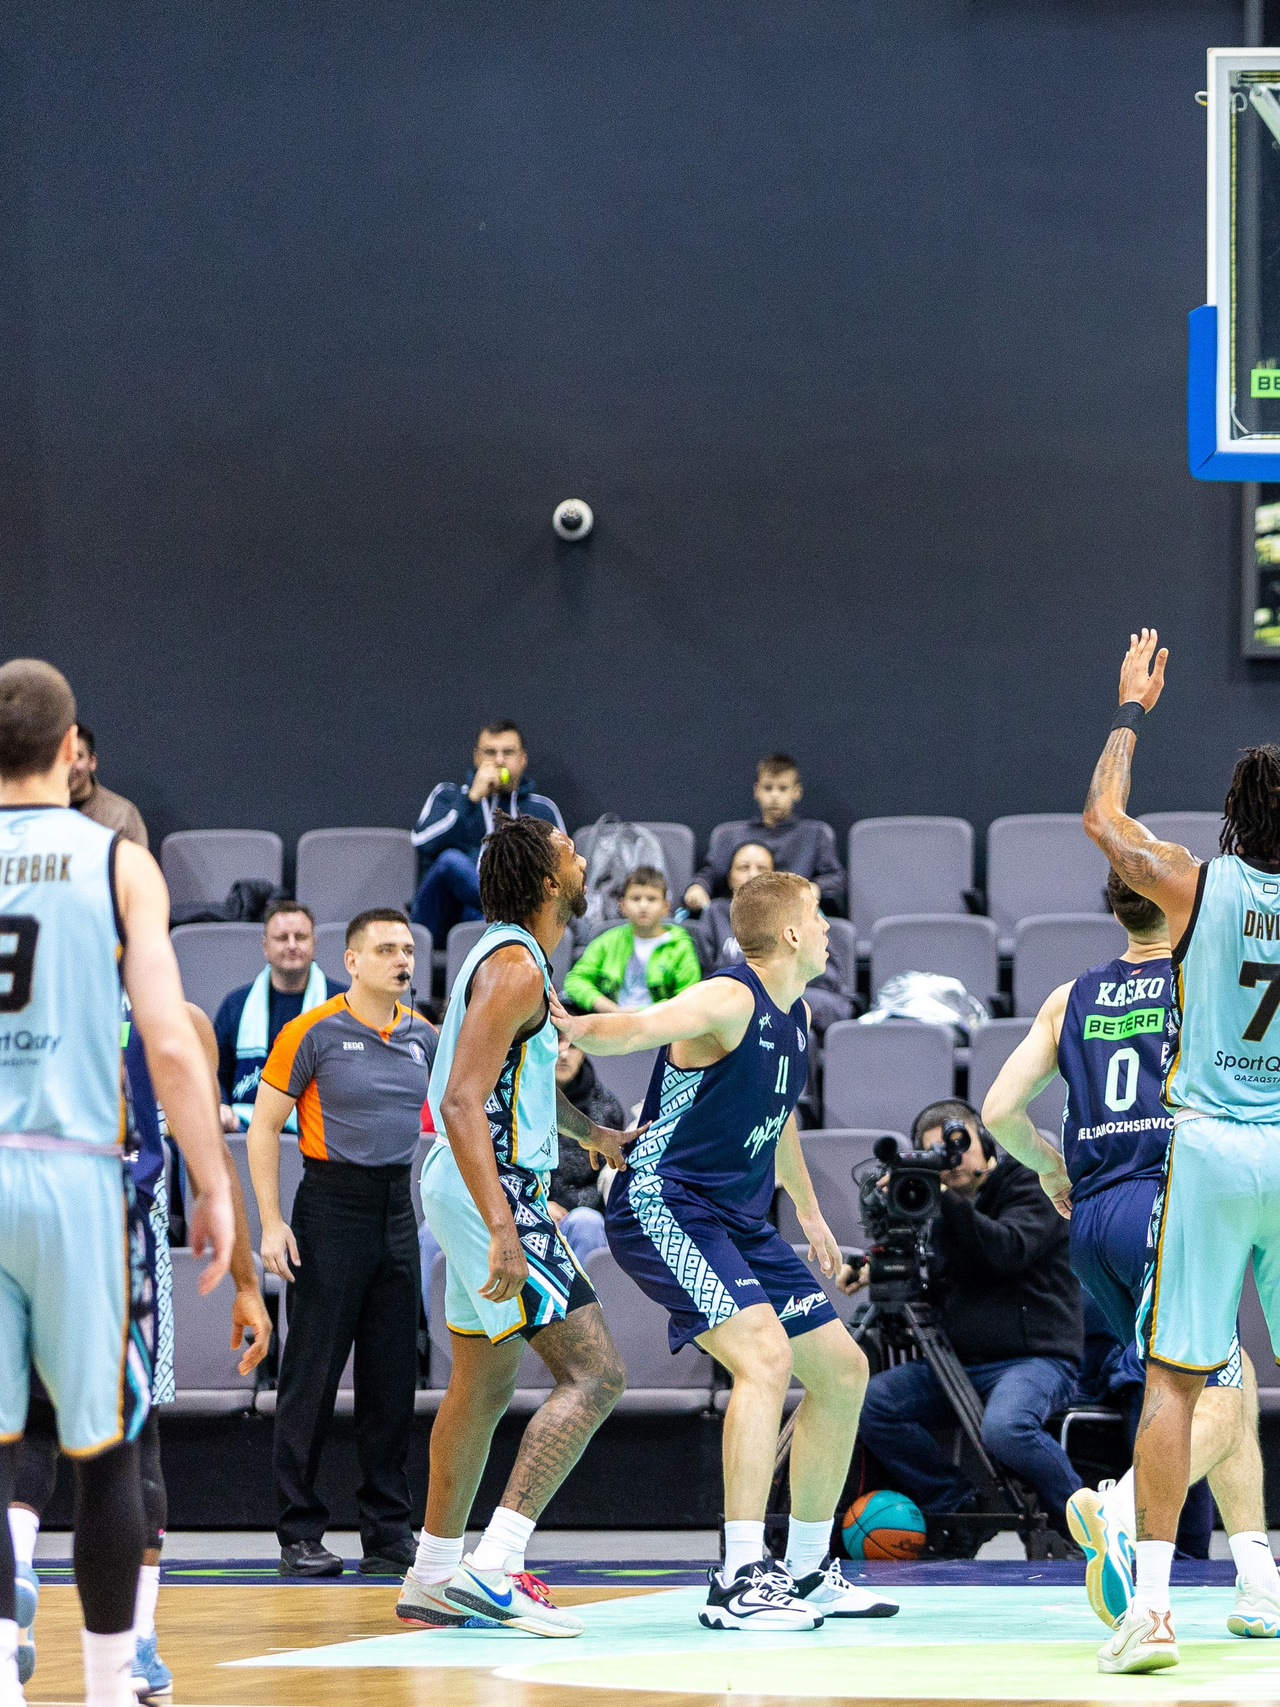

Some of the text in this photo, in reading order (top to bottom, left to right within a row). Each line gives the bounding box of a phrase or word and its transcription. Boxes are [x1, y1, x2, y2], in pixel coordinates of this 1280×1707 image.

[1095, 978, 1165, 1007] KASKO
[774, 1055, 789, 1094] 11
[1104, 1047, 1140, 1112] 0
